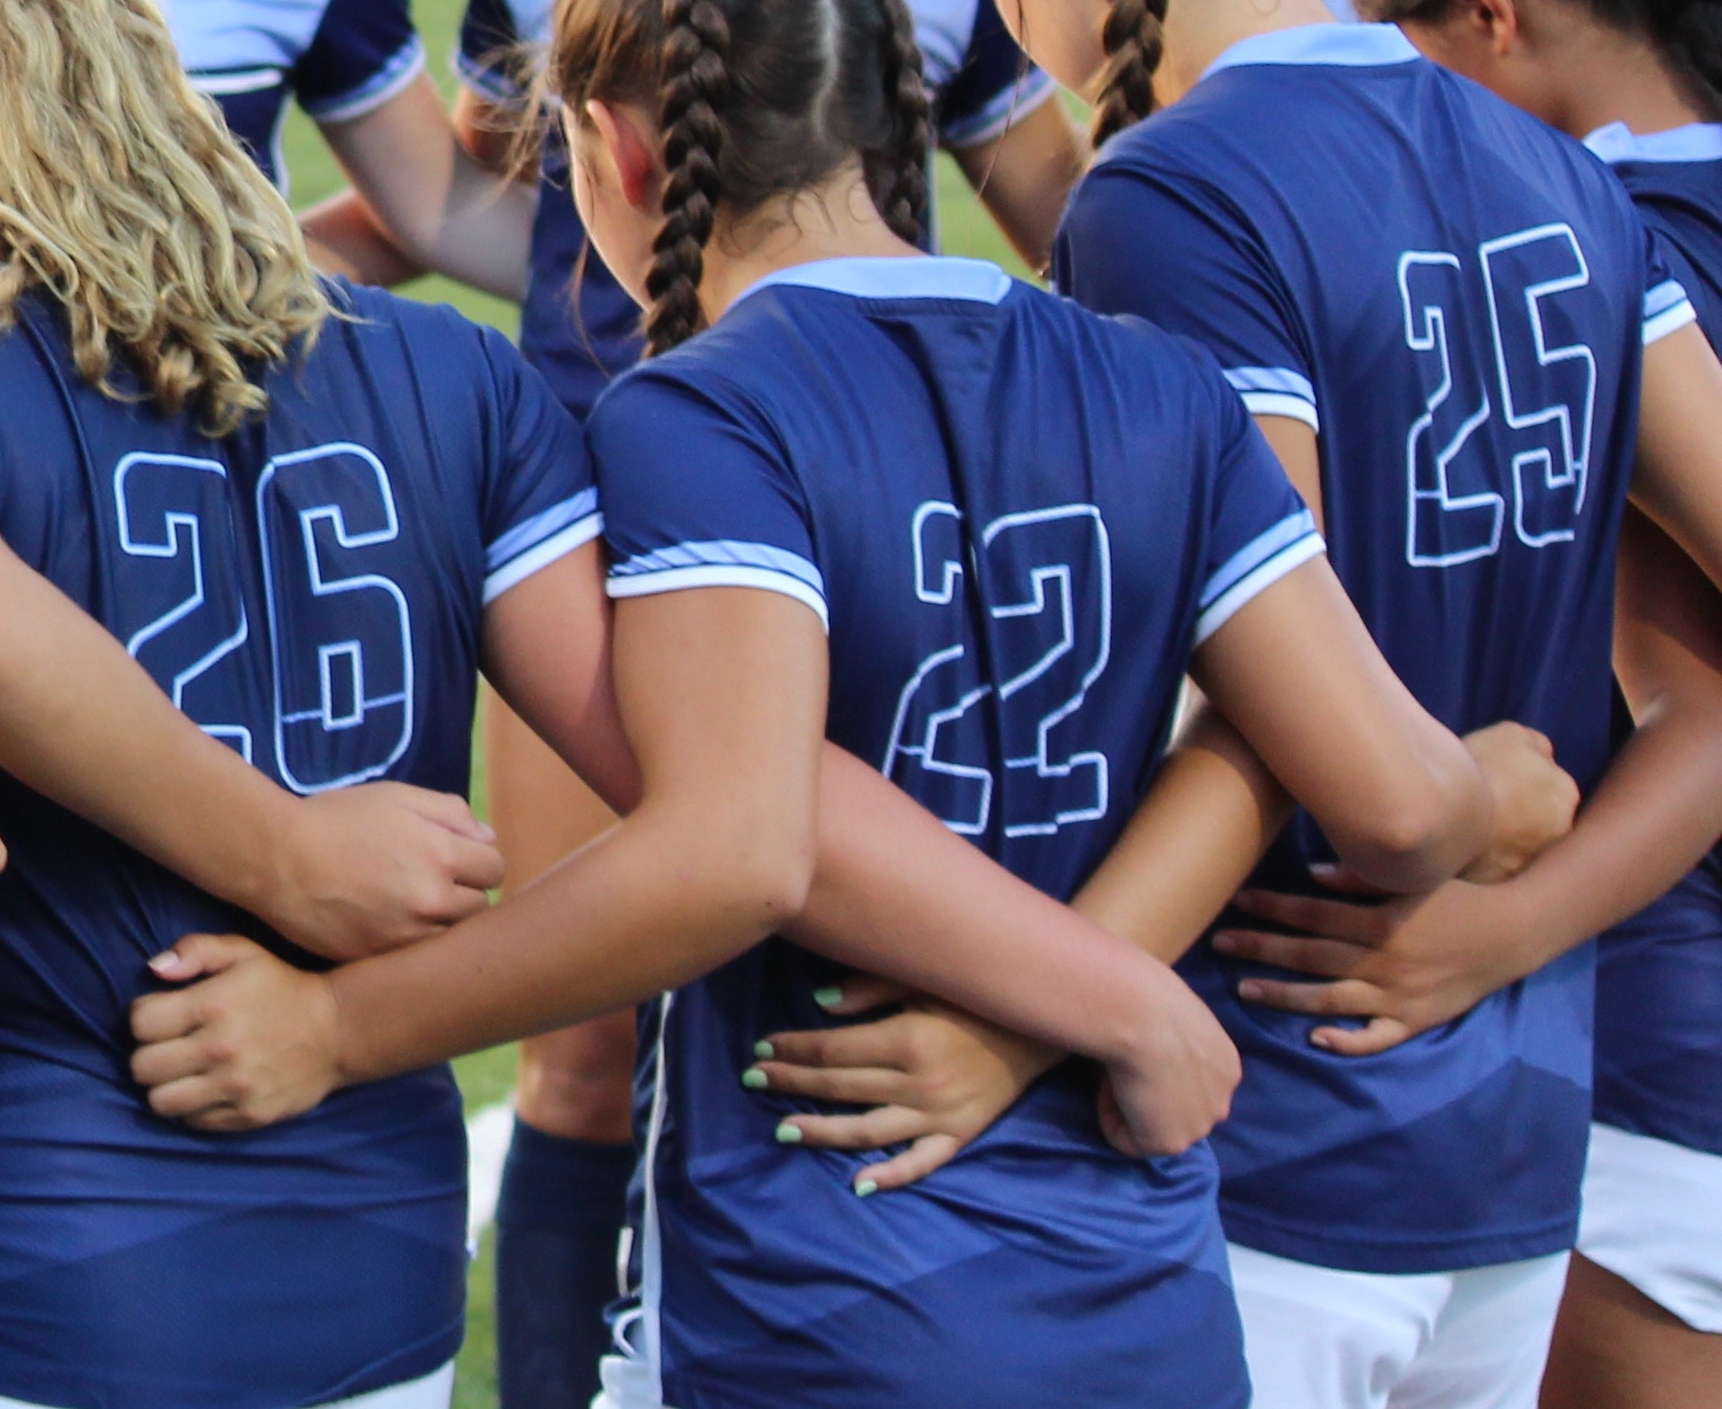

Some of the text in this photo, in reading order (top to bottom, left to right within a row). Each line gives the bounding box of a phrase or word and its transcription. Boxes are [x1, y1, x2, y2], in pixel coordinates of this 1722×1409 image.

[1397, 221, 1596, 568] 25
[113, 440, 415, 795] 26
[882, 499, 1112, 839] 22
